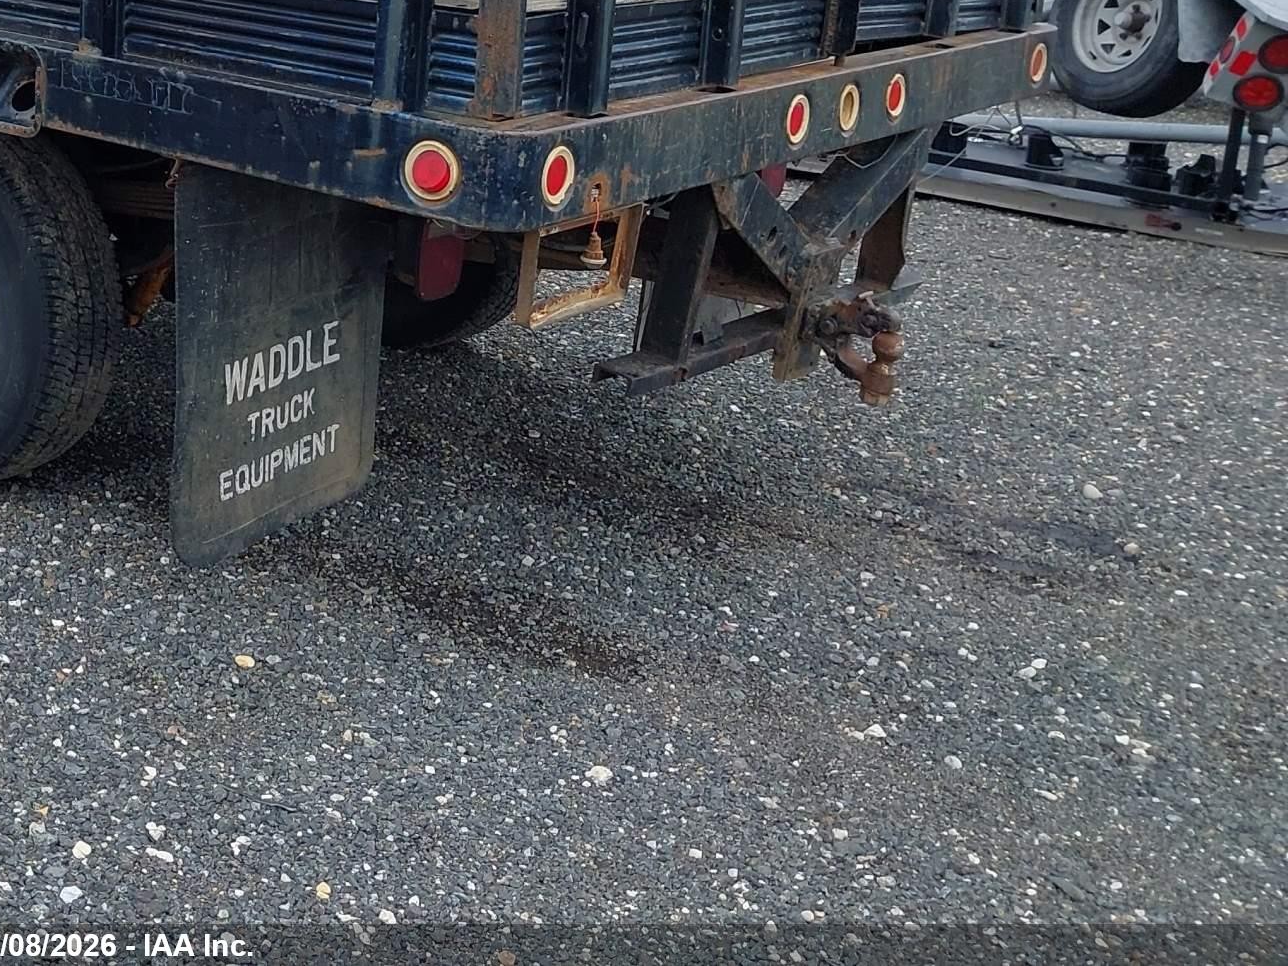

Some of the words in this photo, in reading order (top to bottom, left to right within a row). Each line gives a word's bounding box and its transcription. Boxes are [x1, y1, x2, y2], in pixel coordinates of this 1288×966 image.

[224, 321, 340, 405] WADDLE
[247, 388, 315, 441] TRUCK
[219, 424, 340, 501] EQUIPMENT
